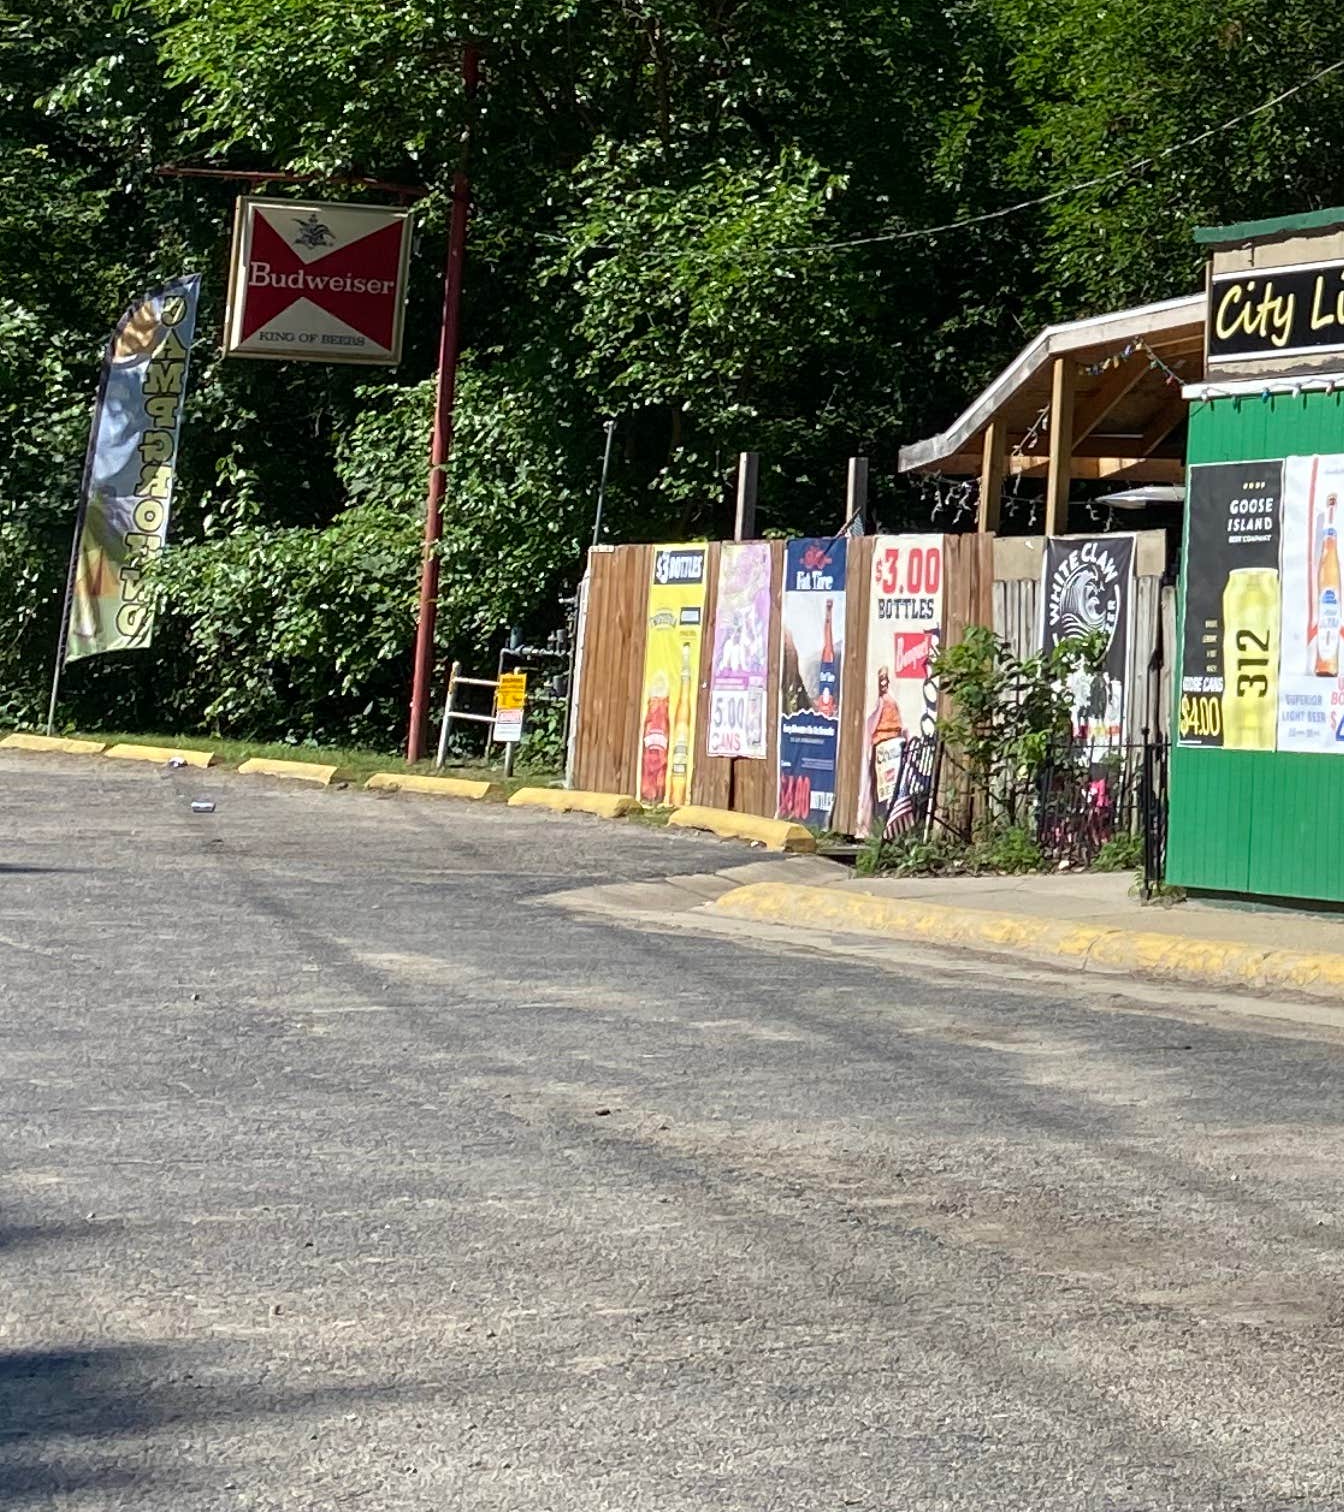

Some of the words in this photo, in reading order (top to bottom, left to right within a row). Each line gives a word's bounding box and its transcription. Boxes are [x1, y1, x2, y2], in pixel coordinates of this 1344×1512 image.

[249, 261, 394, 294] Budweiser
[1216, 281, 1294, 347] City
[259, 331, 295, 342] KING
[298, 333, 316, 343] OF
[1229, 497, 1274, 515] GOOSE
[1227, 517, 1273, 533] ISLAND
[876, 548, 940, 594] $3.00
[1049, 549, 1079, 626] WHITE
[1081, 542, 1119, 583] CLAW
[878, 598, 934, 619] BOTTLES
[1236, 629, 1270, 698] 312
[1180, 694, 1221, 738] $4.00
[711, 731, 741, 752] CANS
